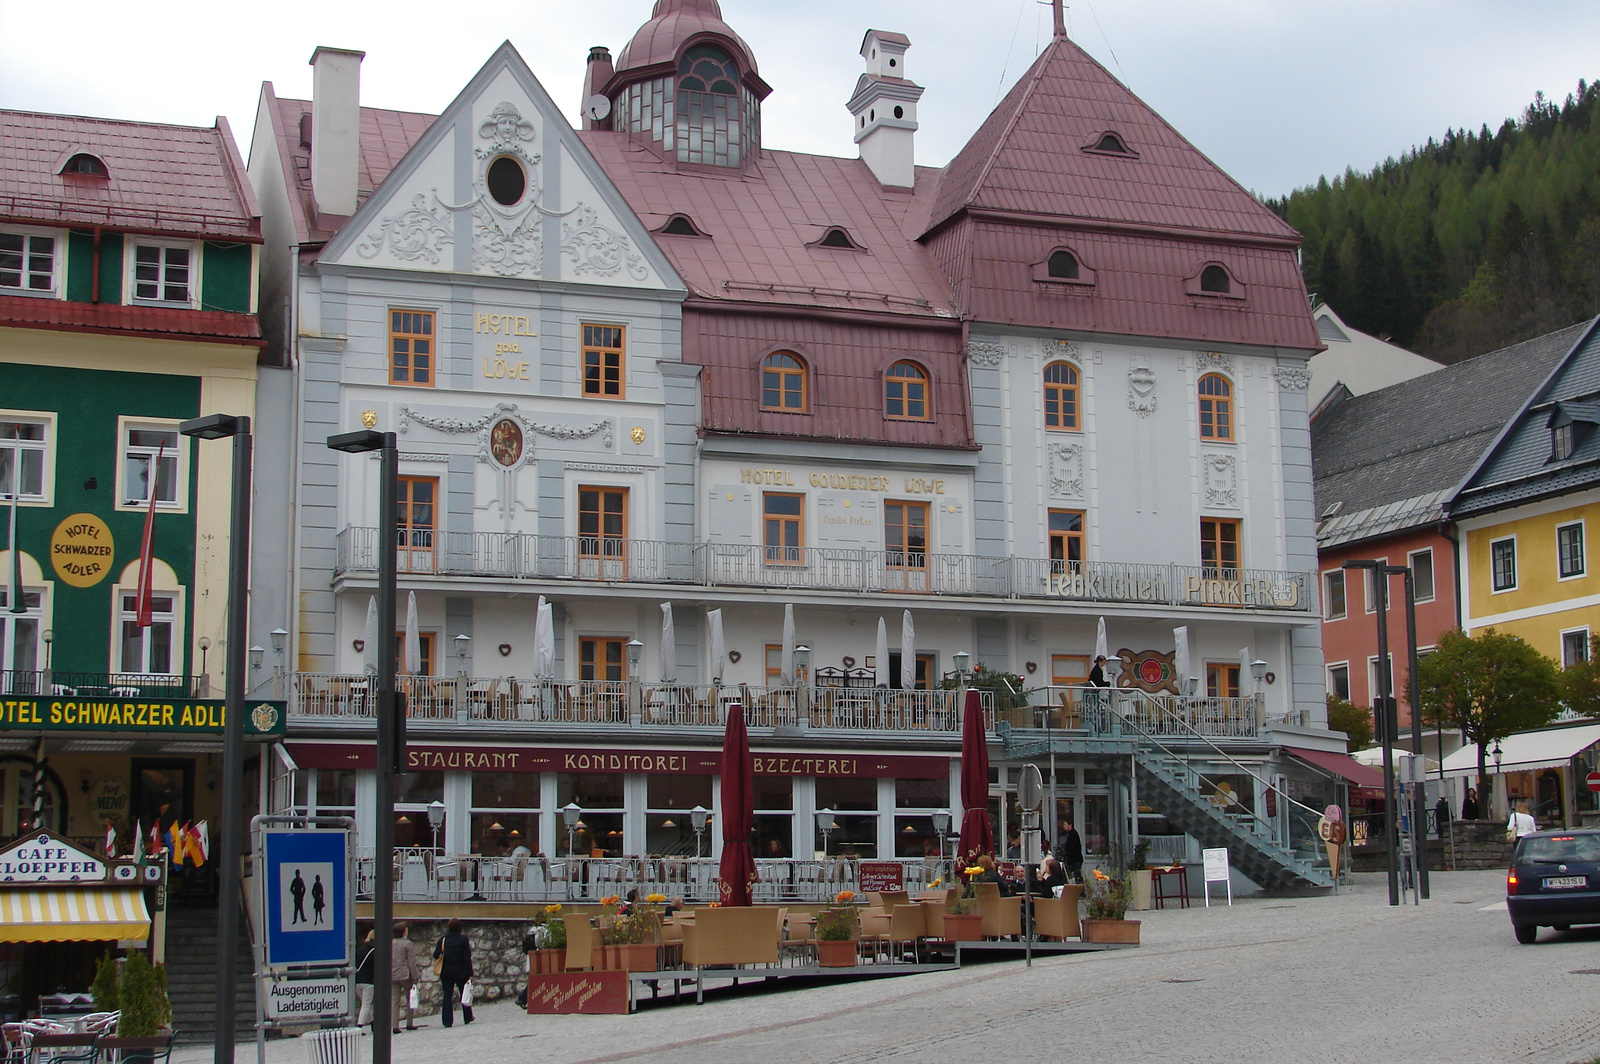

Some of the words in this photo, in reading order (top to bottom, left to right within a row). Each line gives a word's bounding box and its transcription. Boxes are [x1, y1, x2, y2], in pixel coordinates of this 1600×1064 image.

[476, 312, 538, 337] HOTEL
[495, 341, 522, 356] gold.
[483, 357, 530, 380] LÖWE
[741, 468, 794, 486] HOTEL
[809, 472, 889, 491] GOLDENER
[65, 524, 101, 540] HOTEL
[54, 544, 112, 556] SCHWARZER
[63, 562, 101, 576] ADLER
[1046, 569, 1166, 600] Lebkuchen
[1185, 575, 1298, 607] PIRKER
[51, 702, 174, 726] SCHWARZER
[181, 705, 245, 728] ADLE
[409, 751, 519, 769] STAURANT
[564, 754, 687, 772] KONDITOREI
[753, 756, 857, 775] BZELTEREI
[17, 848, 67, 860] CAFE
[0, 861, 97, 874] LOEPFER
[271, 984, 346, 998] Ausgenommen
[277, 998, 339, 1013] Ladetätigkeit
